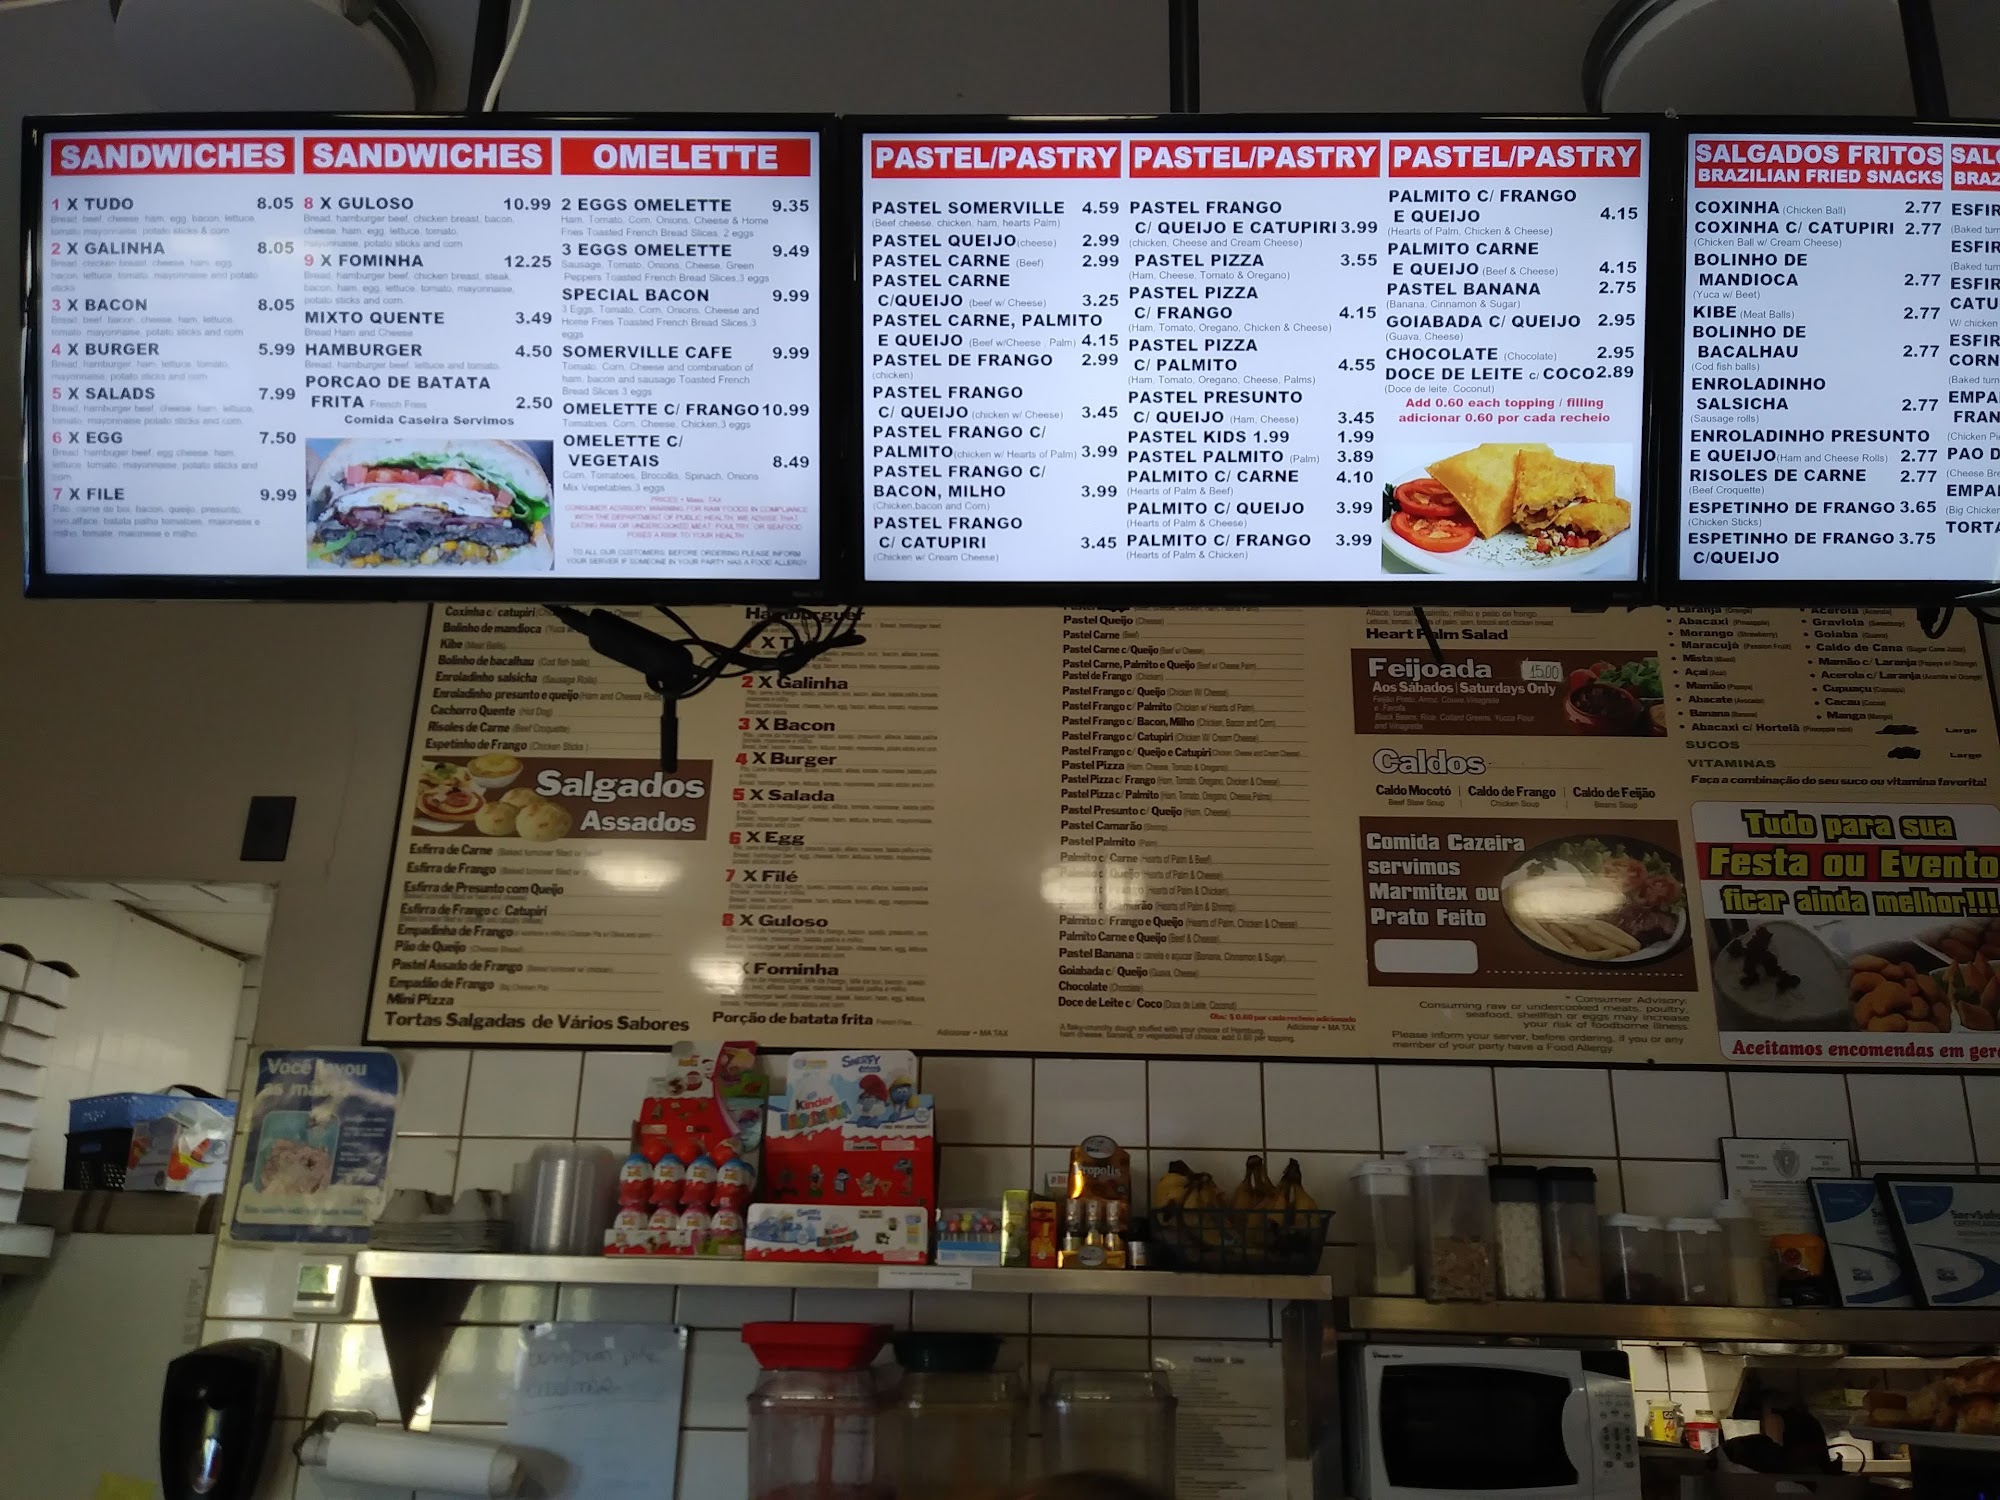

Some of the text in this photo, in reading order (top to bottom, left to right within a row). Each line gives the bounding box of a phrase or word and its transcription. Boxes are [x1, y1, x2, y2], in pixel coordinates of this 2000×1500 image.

[61, 143, 285, 170] SANDWICHES
[311, 142, 543, 170] SANDWICHES
[593, 143, 778, 170] OMELETTE
[875, 147, 1116, 169] PASTEL/PASTRY
[1134, 146, 1377, 169] PASTEL/PASTRY
[1393, 146, 1636, 169] PASTEL/PASTRY
[1696, 144, 1943, 166] SALGADOS FRITOS
[1698, 168, 1942, 184] BRAZILIAN FRIED SNACKS
[52, 197, 293, 211] 1 X TUDO 8.05
[562, 198, 809, 212] 2 EGGS OMELETTE 9.35
[872, 201, 1120, 214] PASTEL SOMERVILLE 4.59
[1695, 201, 1942, 216] COXINHA (Chicken Ball) 2.77
[1002, 218, 1030, 228] hearts
[1032, 218, 1061, 228] Palm)
[52, 242, 294, 255] 2 X GALINHA 8.05
[1173, 239, 1206, 247] Cheese
[1209, 239, 1227, 247] and
[1231, 239, 1262, 247] Cream
[1265, 238, 1303, 248] Cheese)
[304, 254, 552, 268] 9 X FOMINHA 12.25
[872, 254, 1120, 268] PASTEL CARNE (Beef) 2.99
[1200, 271, 1235, 279] Tomato
[1238, 271, 1244, 279] &
[1247, 271, 1290, 280] Oregano)
[562, 288, 809, 302] SPECIAL BACON 9.99
[305, 312, 552, 327] MIXTO QUENTE 3.49
[1693, 306, 1940, 320] KIBE (Meat Balls) 2.77
[1424, 332, 1464, 342] Cheese)
[305, 344, 552, 358] HAMBURGER 4.50
[1386, 346, 1635, 362] CHOCOLATE (Chocolate) 2.95
[630, 363, 664, 372] Cheese
[668, 363, 685, 372] and
[688, 363, 741, 372] combination
[744, 363, 754, 372] of
[1128, 391, 1303, 404] PASTEL PRESUNTO
[1398, 412, 1611, 425] adicionar 0.60 por cada recheio
[1690, 414, 1759, 424] (Sausage rolls)
[569, 454, 809, 468] VEGETAIS 8.49
[1690, 469, 1937, 483] RISOLES DE CARNE 2.77
[1127, 486, 1233, 496] (Hearts of Palm & Beef)
[879, 536, 1117, 549] C/ CATUPIRI 3.45
[1813, 618, 1864, 627] Graviola
[1814, 630, 1858, 639] Goiaba
[1368, 657, 1492, 680] Feijoada
[1373, 681, 1556, 696] Aos Sábados Saturdays Only
[1685, 740, 1740, 750] SUCOS
[736, 753, 837, 768] 4 X Burger
[1373, 749, 1486, 774] Caldos
[1688, 759, 1776, 768] VITAMINAS
[536, 770, 706, 803] Salgados
[1468, 785, 1556, 799] Caldo de Frango
[1061, 805, 1092, 816] Pastel
[1093, 806, 1138, 816] Presunto
[1151, 806, 1182, 818] Queijo
[580, 810, 696, 832] Assados
[1742, 811, 1956, 841] Tudo para sua
[1366, 833, 1526, 852] Comida Cazeira
[1368, 858, 1460, 876] servimos
[1709, 847, 1999, 879] Festa ou Evento
[1369, 882, 1500, 902] Marmitex ou
[1720, 886, 1999, 917] ficar ainda melhor!!!
[1371, 908, 1486, 927] Prato Feito
[384, 1012, 690, 1032] Tortas Salgadas de Vários Sabores
[1732, 1039, 1823, 1057] Aceitamos
[1828, 1041, 1935, 1057] encomendas
[1939, 1043, 1965, 1057] em
